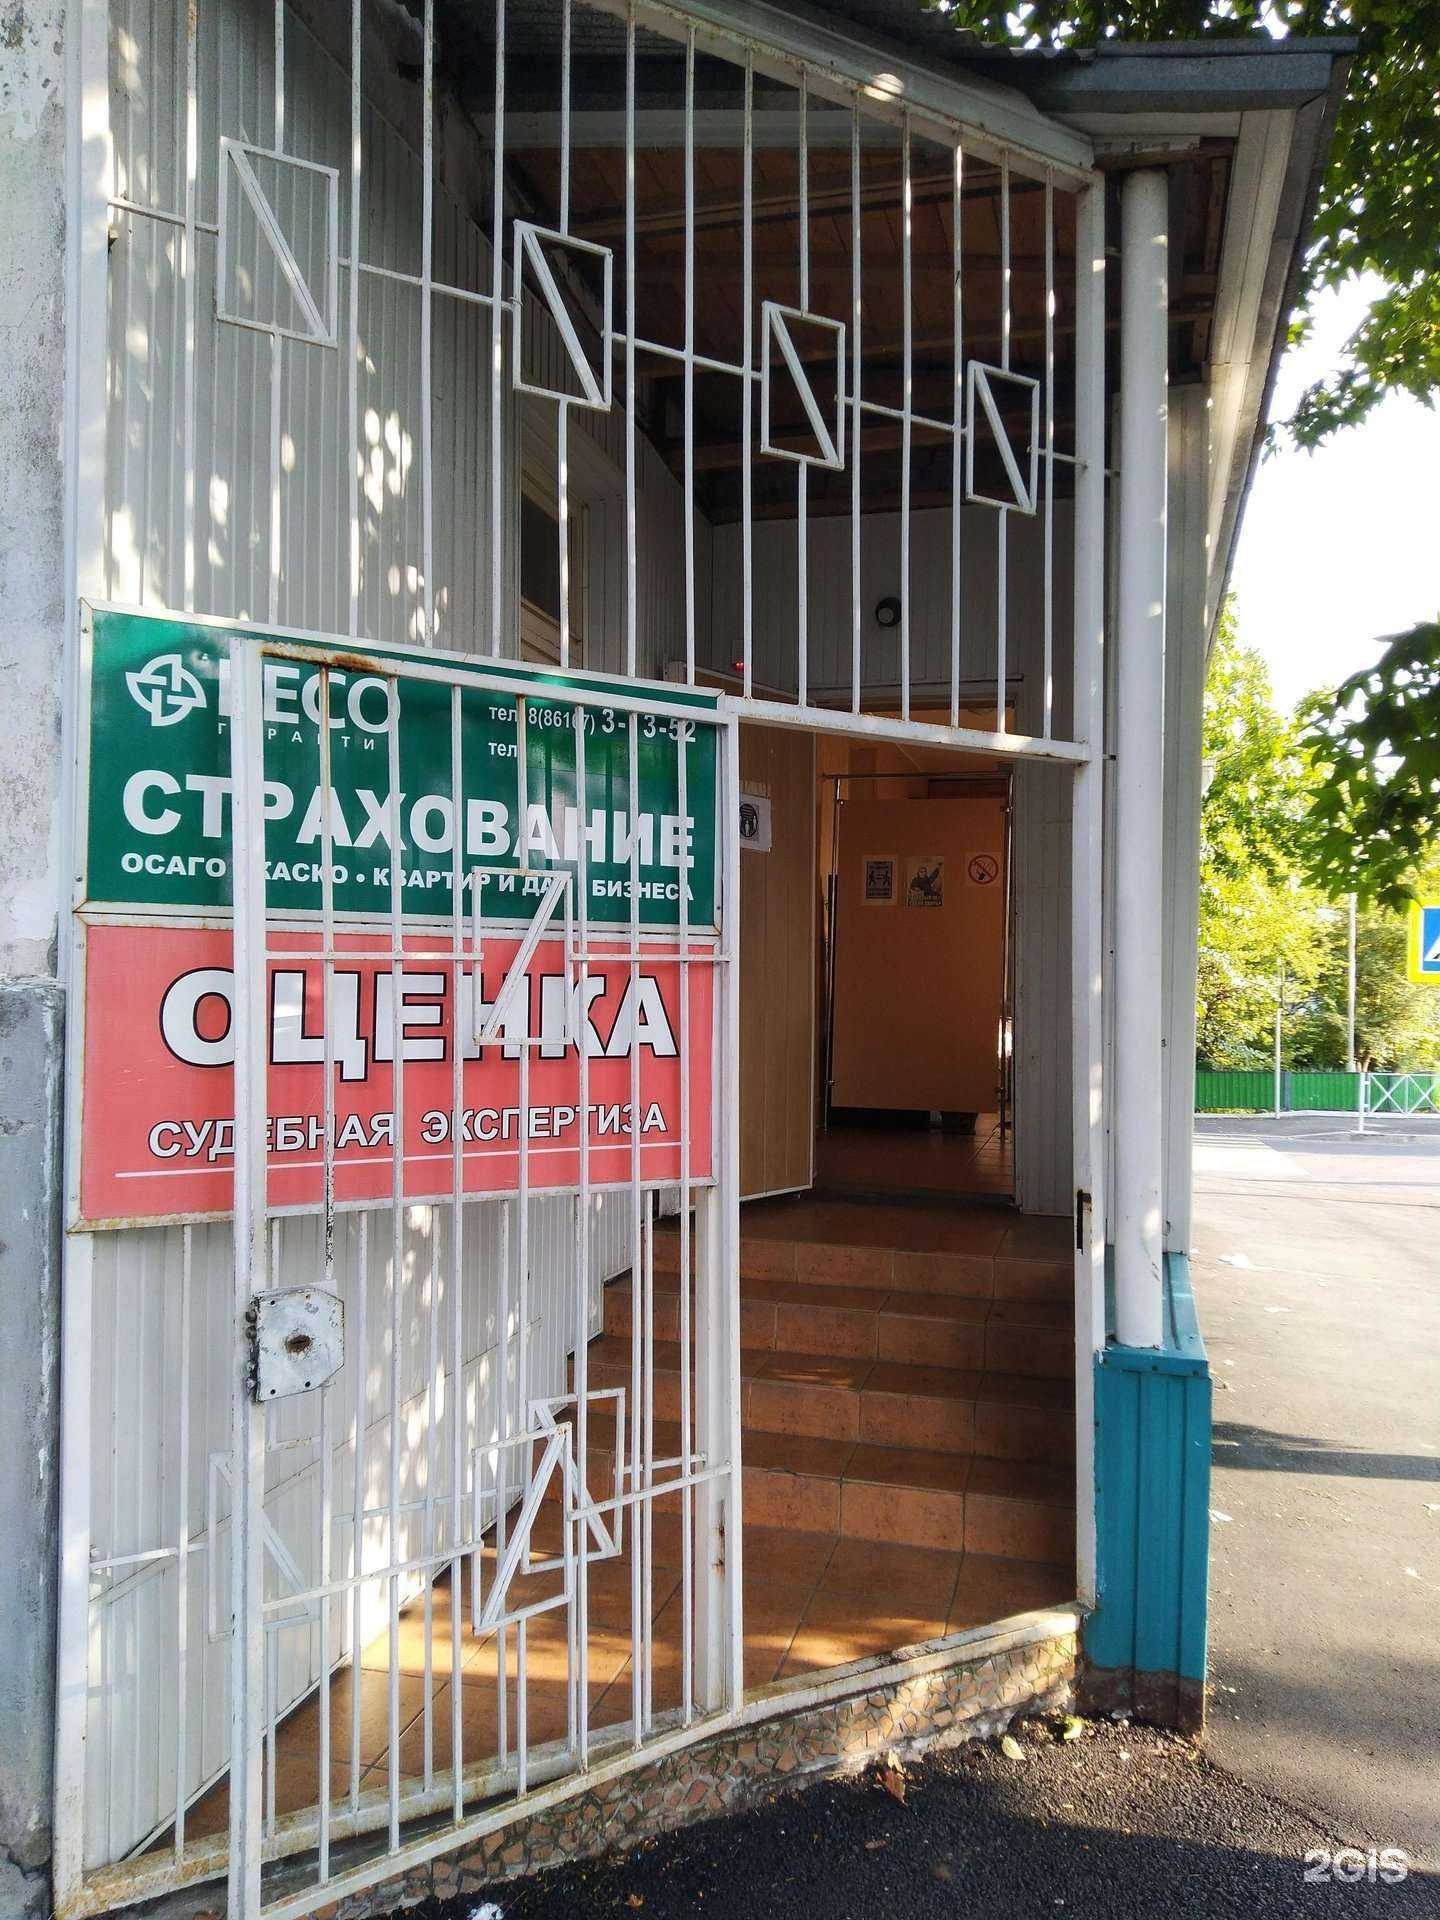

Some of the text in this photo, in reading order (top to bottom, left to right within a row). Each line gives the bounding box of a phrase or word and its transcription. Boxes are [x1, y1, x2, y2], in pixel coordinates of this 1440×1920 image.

[528, 707, 595, 736] 8(8617)
[122, 769, 695, 868] СТРАХОВАНИЕ
[121, 853, 226, 878] ОСАГО
[499, 876, 515, 892] И
[159, 966, 680, 1082] ОЦЕНКА
[420, 1103, 668, 1144] ЭКСПЕРТИЗА
